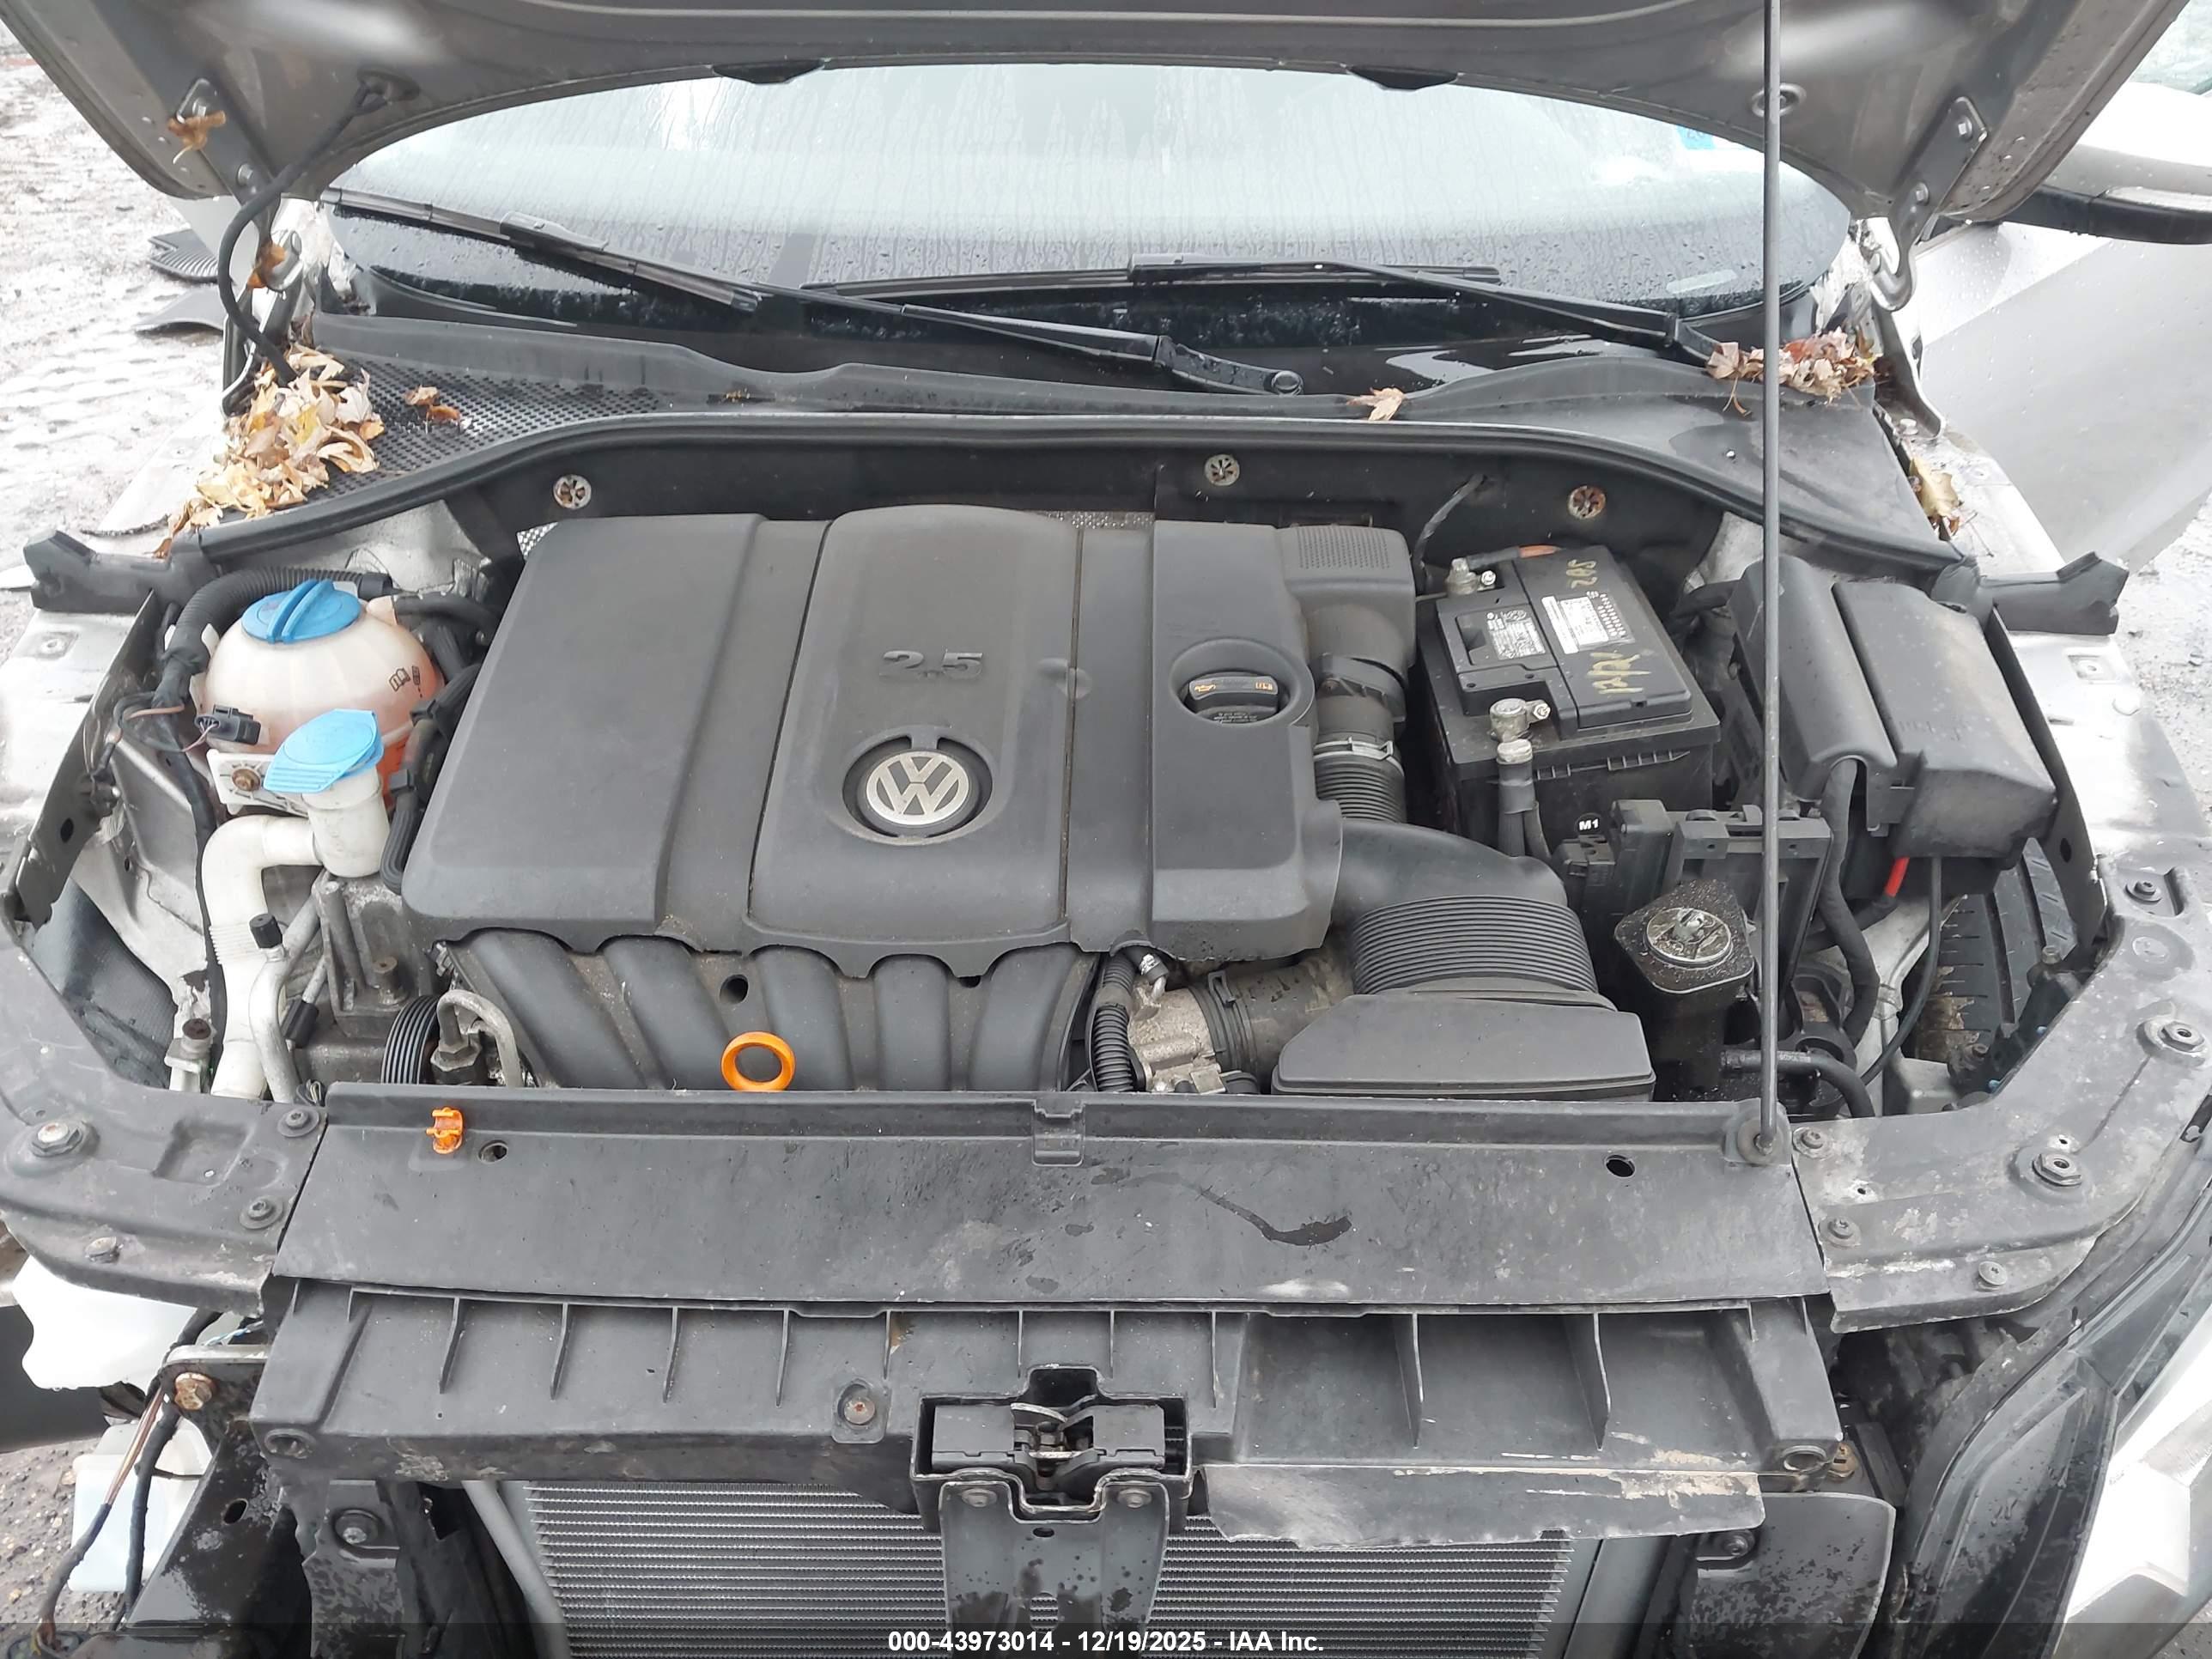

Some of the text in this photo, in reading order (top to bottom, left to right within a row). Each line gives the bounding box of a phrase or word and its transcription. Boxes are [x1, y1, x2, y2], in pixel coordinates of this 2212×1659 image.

[879, 650, 983, 678] 2.5
[867, 751, 968, 824] VW
[1578, 818, 1599, 831] M1
